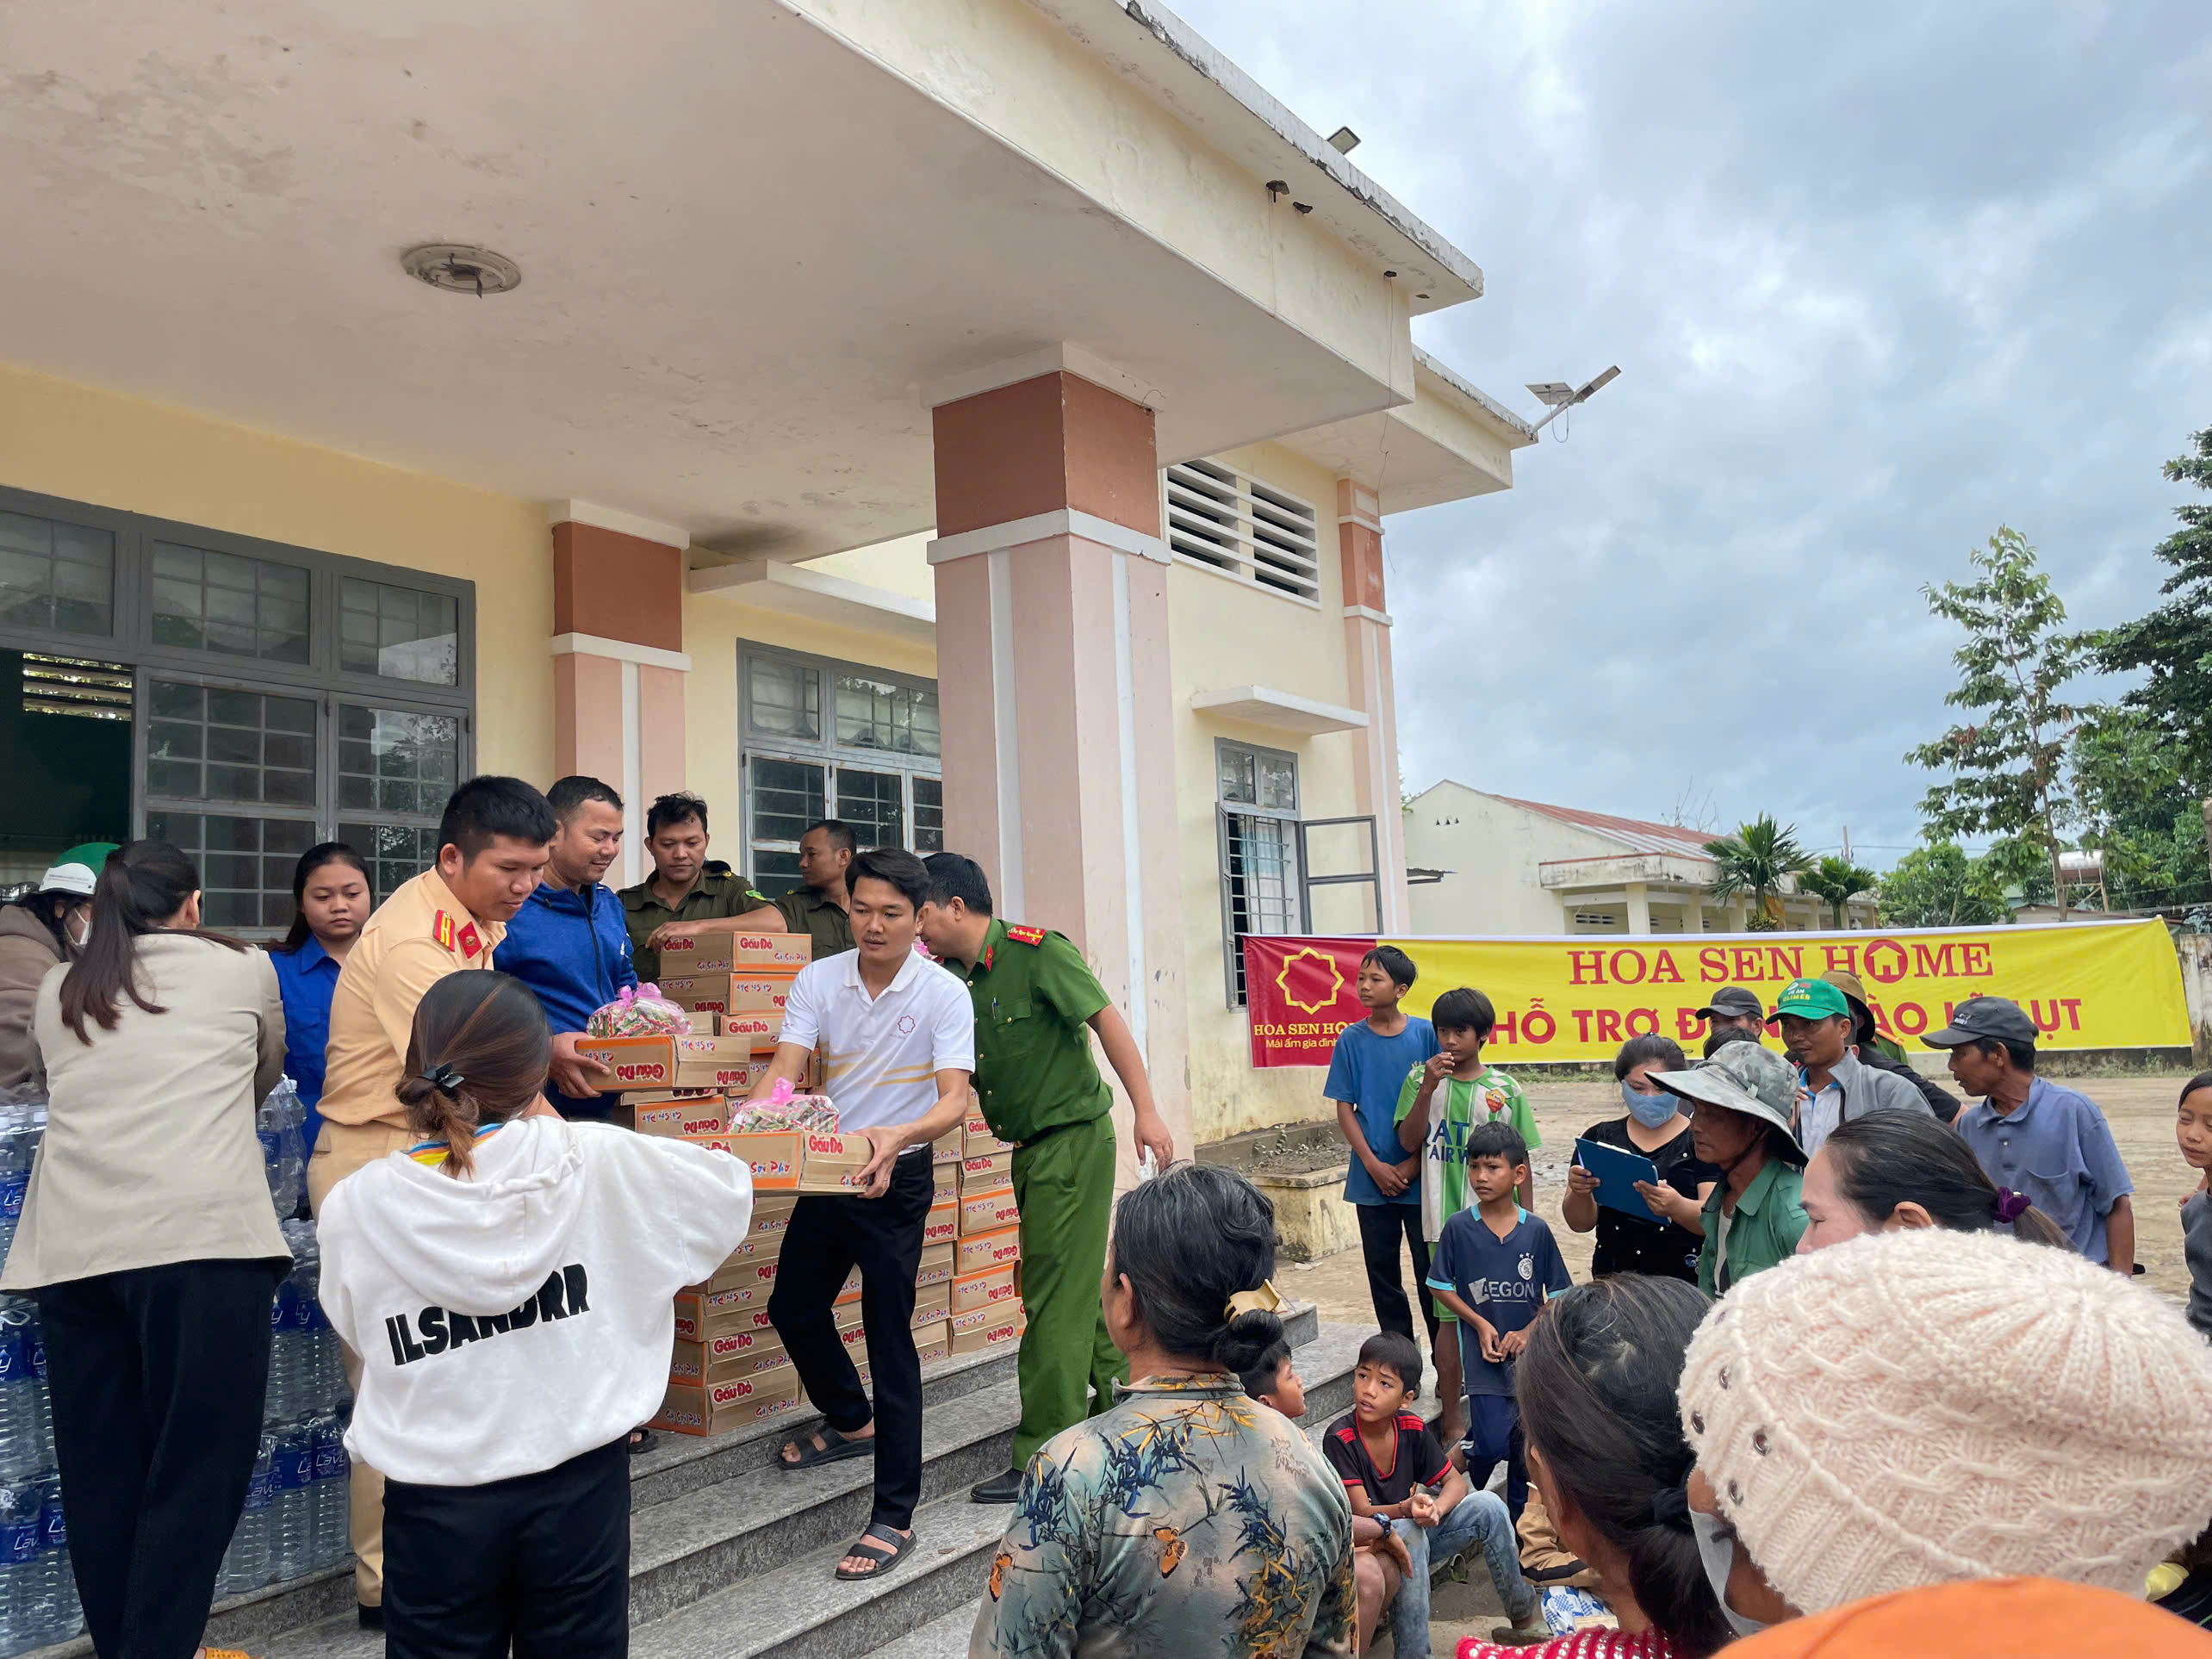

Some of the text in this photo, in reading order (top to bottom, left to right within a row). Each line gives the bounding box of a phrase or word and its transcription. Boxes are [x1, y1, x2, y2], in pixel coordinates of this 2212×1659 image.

[1567, 939, 1994, 985] HOA SEN HOME
[1254, 1024, 1286, 1036] HOA
[1288, 1023, 1320, 1035] SEN
[1488, 997, 1556, 1044] HỖ
[1265, 1039, 1283, 1048] Mái
[1284, 1037, 1302, 1048] ấm
[1302, 1038, 1317, 1050] gia
[1429, 1145, 1469, 1165] AIRW
